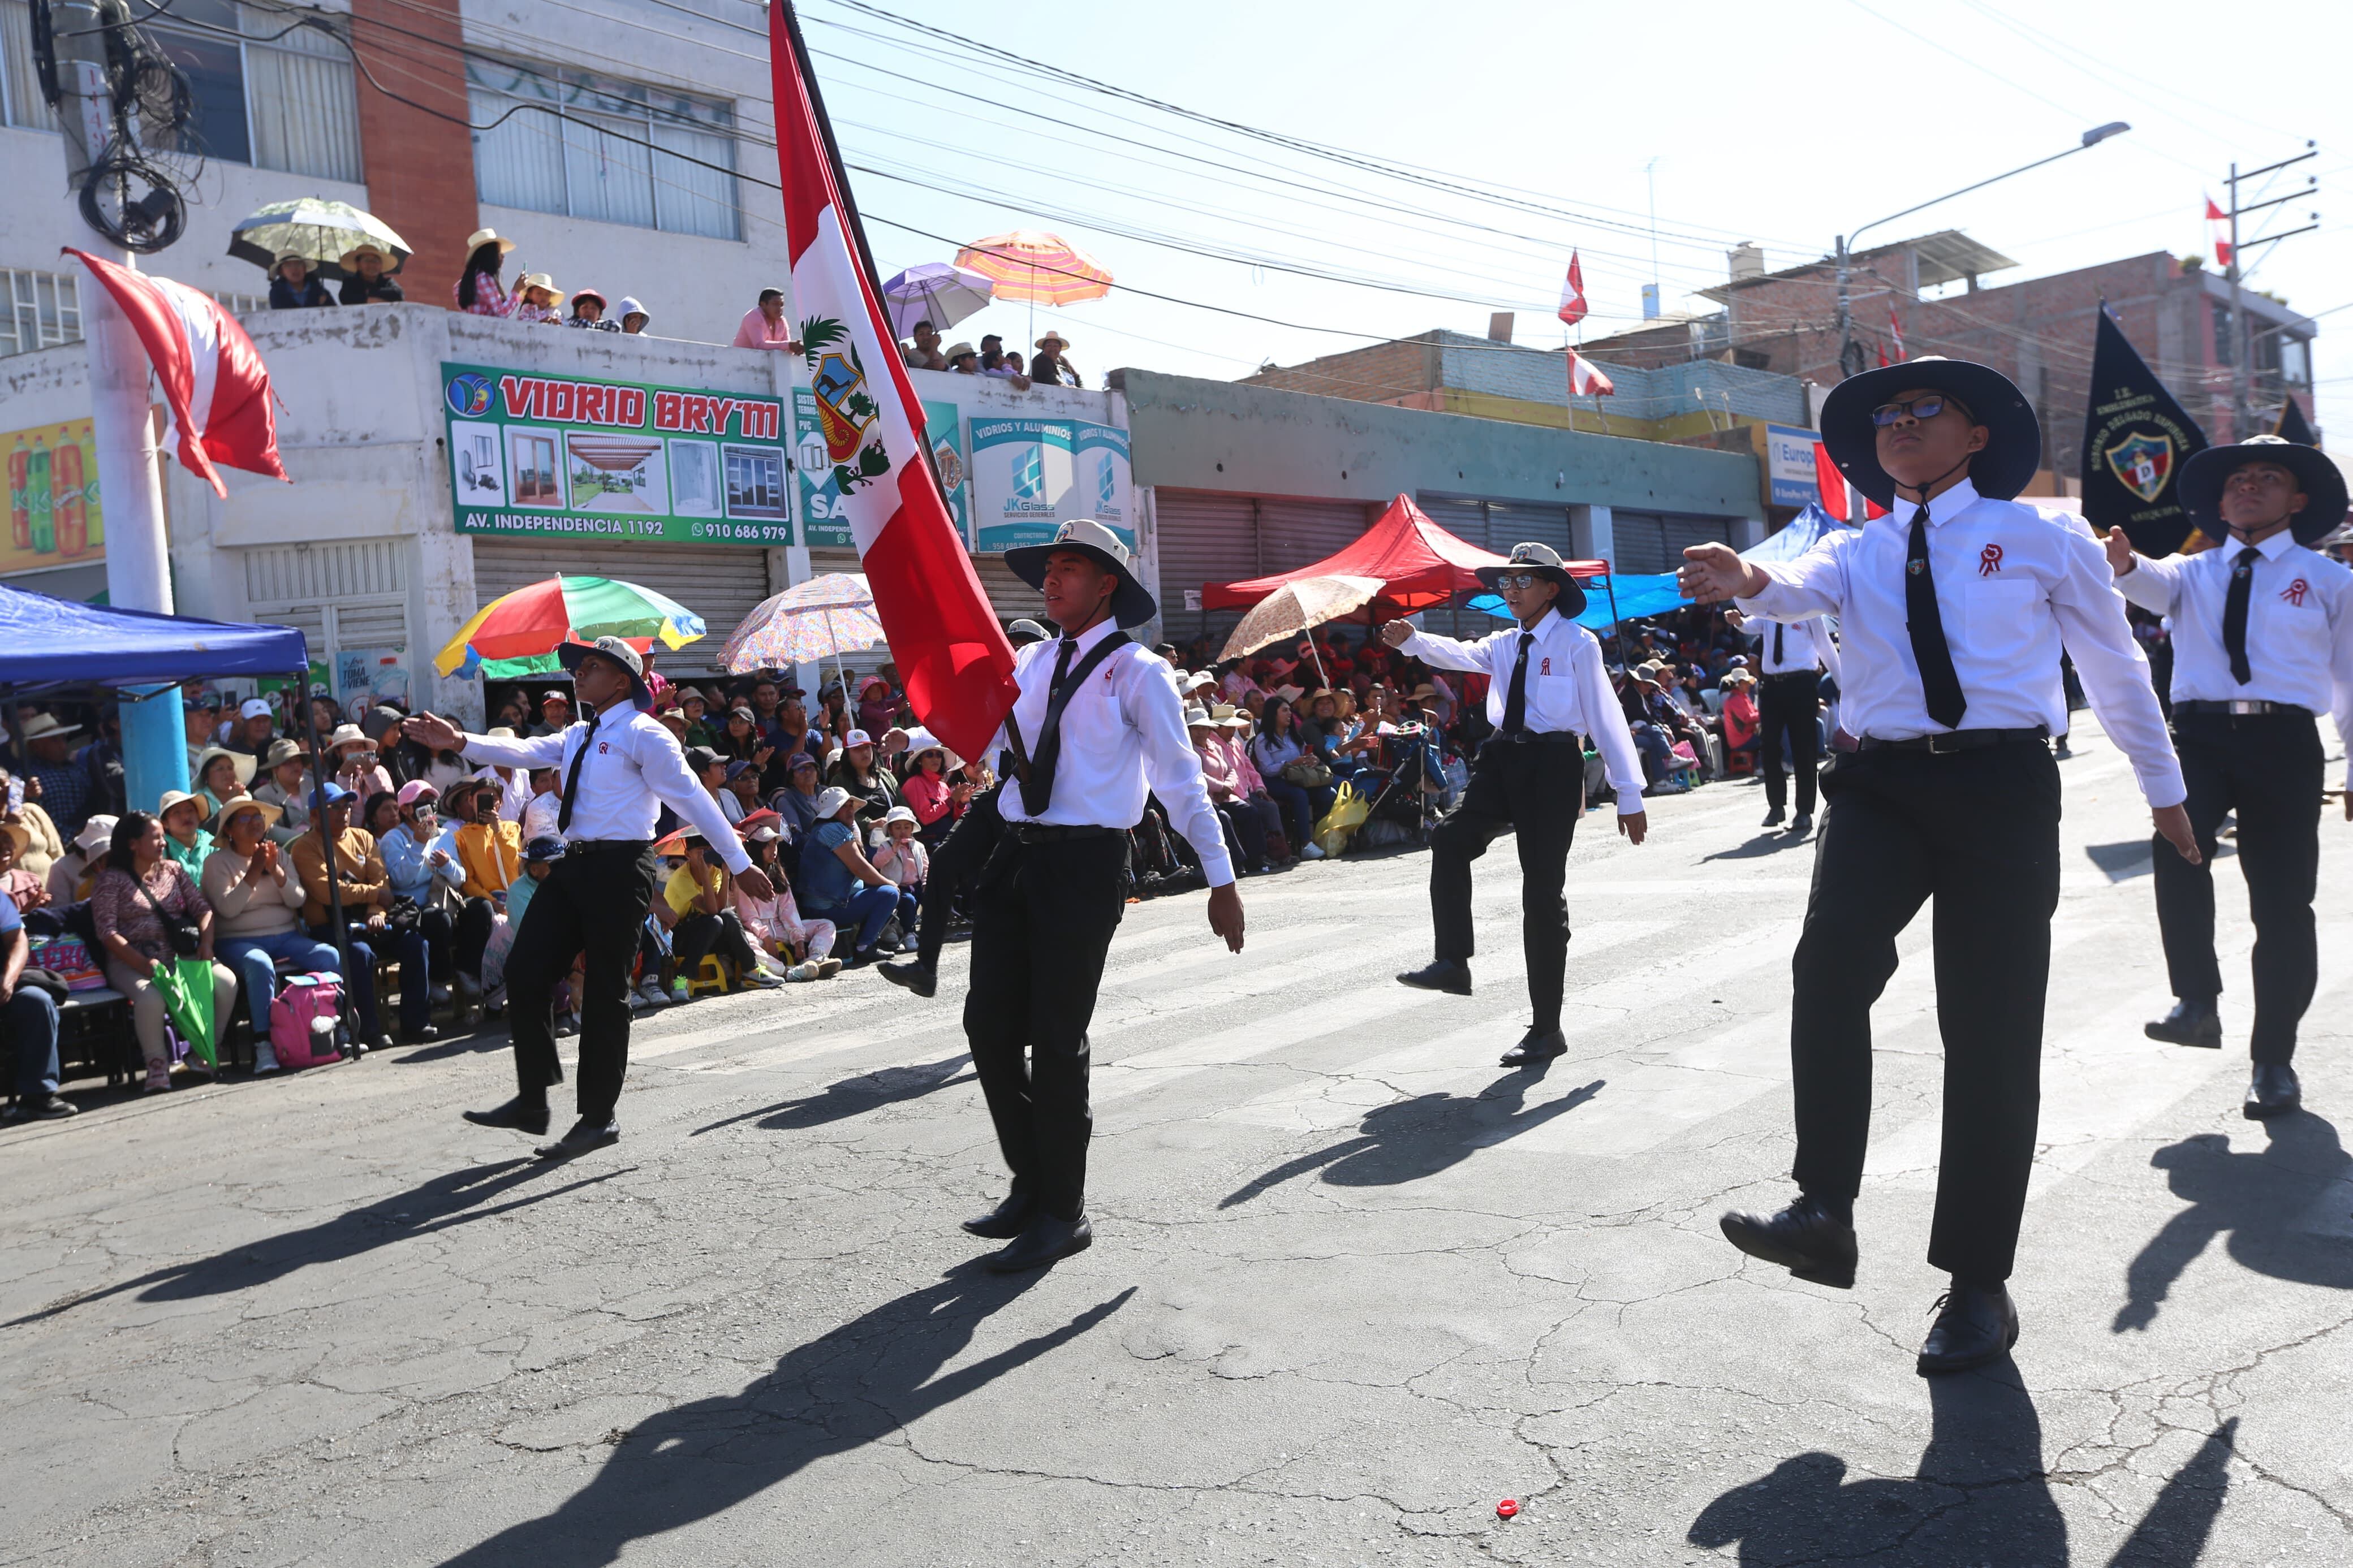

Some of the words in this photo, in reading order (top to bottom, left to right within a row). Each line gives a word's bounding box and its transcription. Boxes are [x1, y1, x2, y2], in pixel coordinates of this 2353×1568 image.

[499, 375, 647, 428] VIDRIO
[796, 394, 818, 405] SISTE
[799, 420, 812, 431] PVC
[2106, 410, 2152, 431] DELGADO
[975, 423, 1013, 439] VIDRIOS
[1014, 422, 1021, 431] Y
[1023, 422, 1072, 441] ALUMINIOS
[465, 513, 490, 528] AV.
[494, 514, 623, 534] INDEPENDENCIA
[628, 520, 664, 535] 1192
[705, 523, 731, 538] 910
[734, 525, 759, 539] 686
[762, 525, 787, 541] 979
[344, 667, 365, 680] TOMA
[347, 675, 370, 690] VIENE
